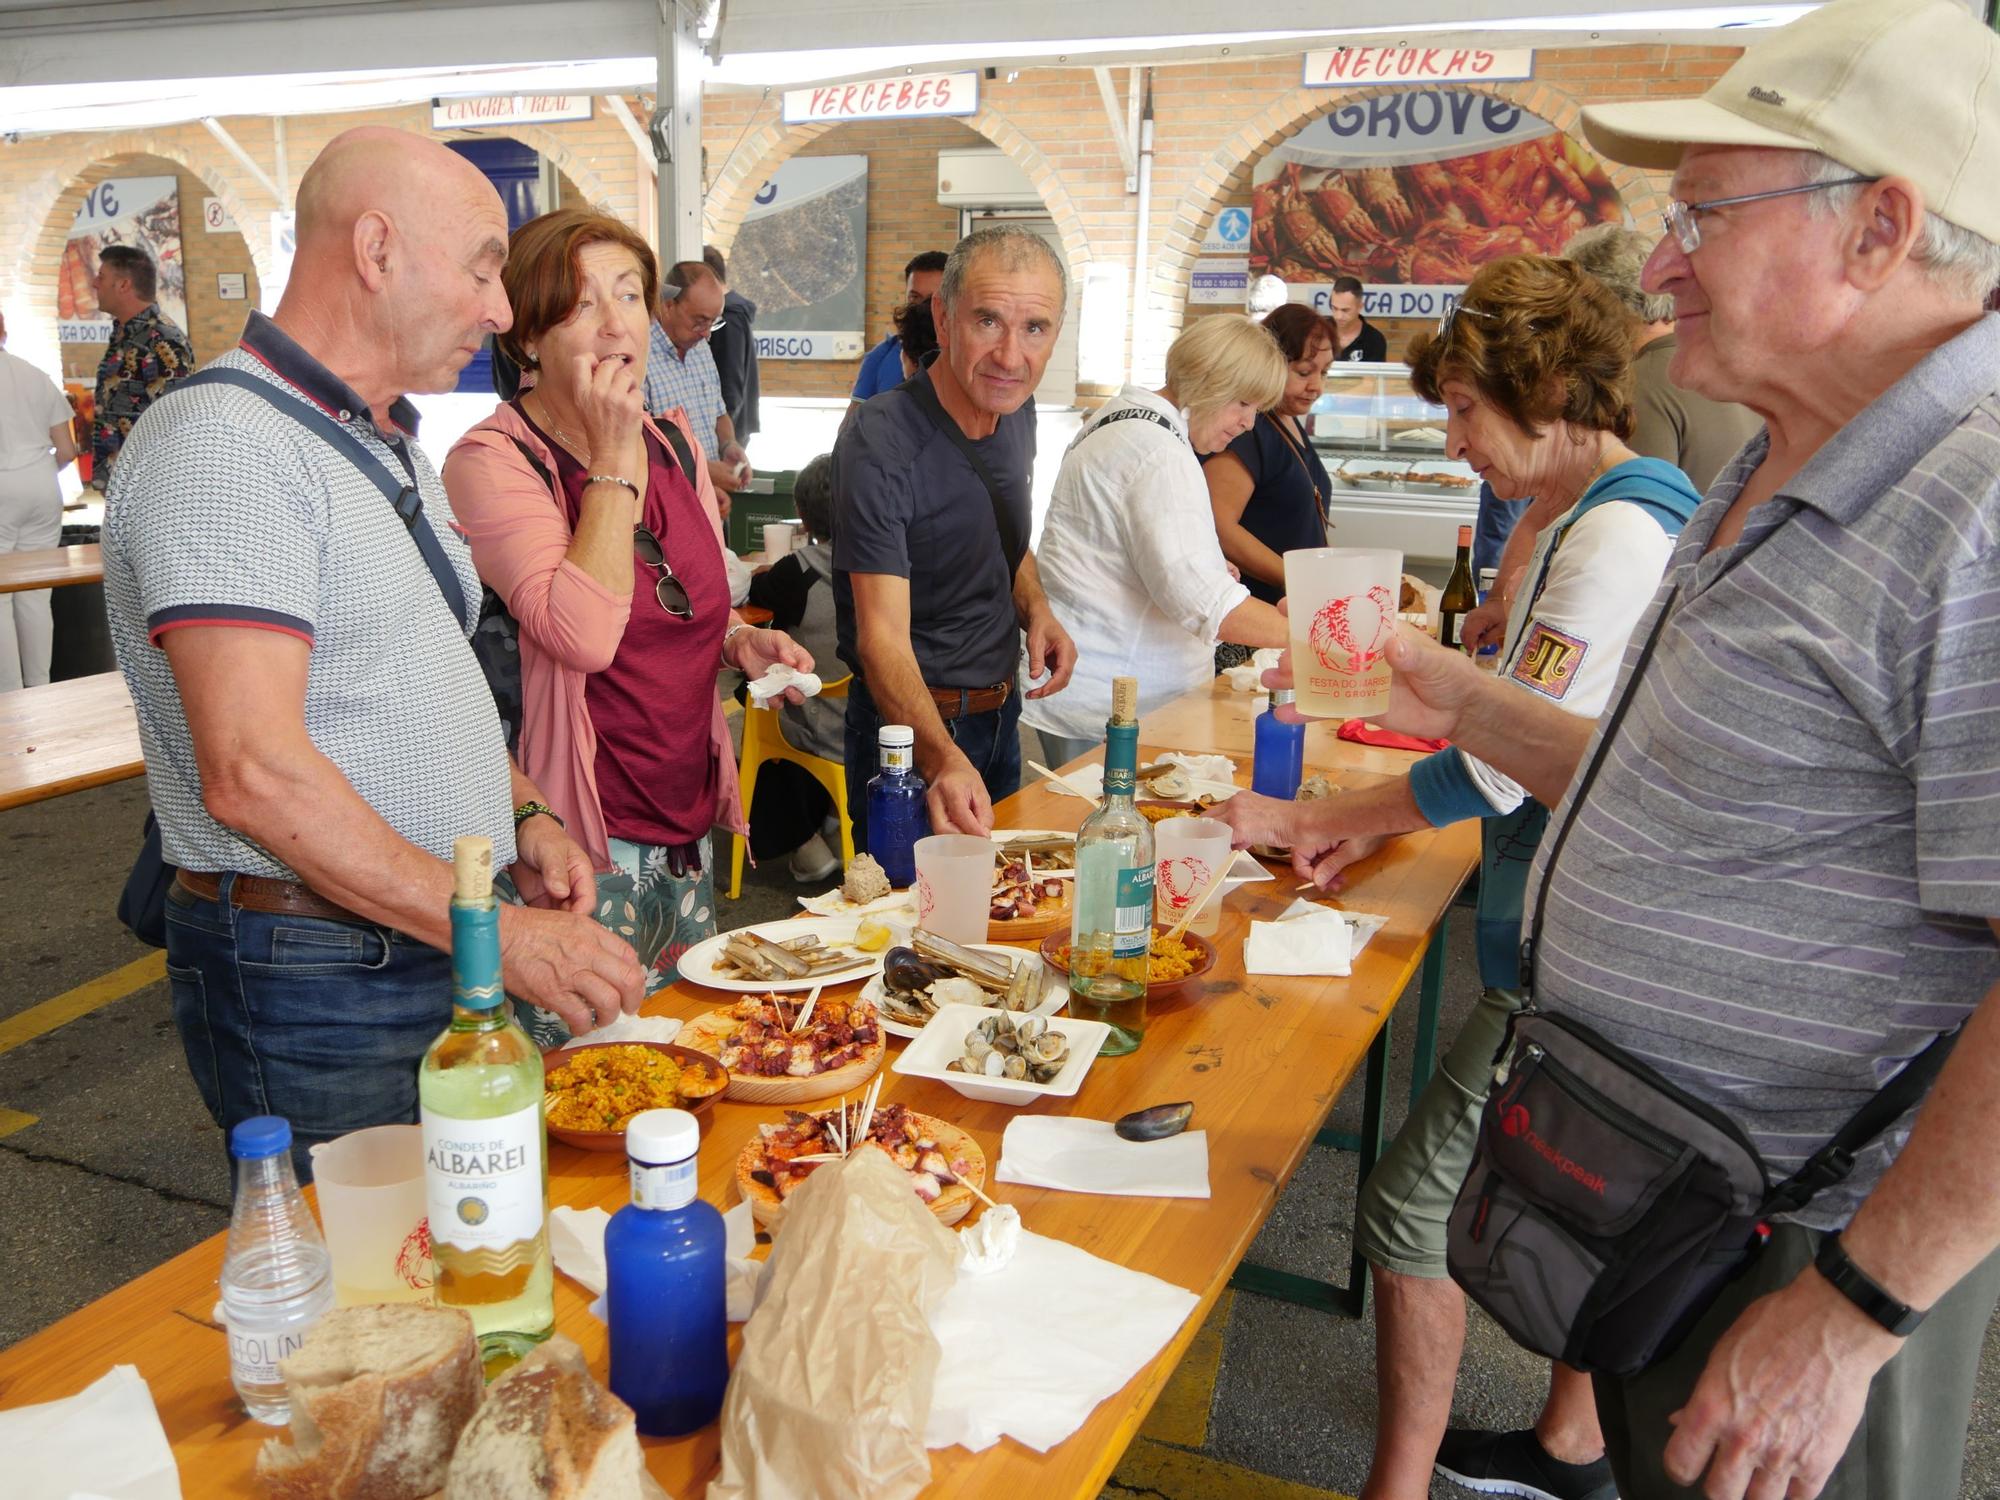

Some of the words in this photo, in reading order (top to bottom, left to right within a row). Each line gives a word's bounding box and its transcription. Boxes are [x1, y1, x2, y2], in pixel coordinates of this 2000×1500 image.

[1328, 89, 1521, 139] GROVE
[1400, 292, 1434, 314] DO
[80, 325, 97, 340] DO
[1108, 408, 1161, 423] BIMBA
[1310, 677, 1339, 689] FESTA
[1341, 680, 1357, 689] DO
[1333, 690, 1340, 698] O
[1344, 689, 1377, 698] GROVE
[438, 1139, 486, 1153] CONDES
[489, 1139, 505, 1151] DE
[427, 1144, 526, 1176] ALBAREI
[447, 1181, 497, 1191] ALBARIÑO
